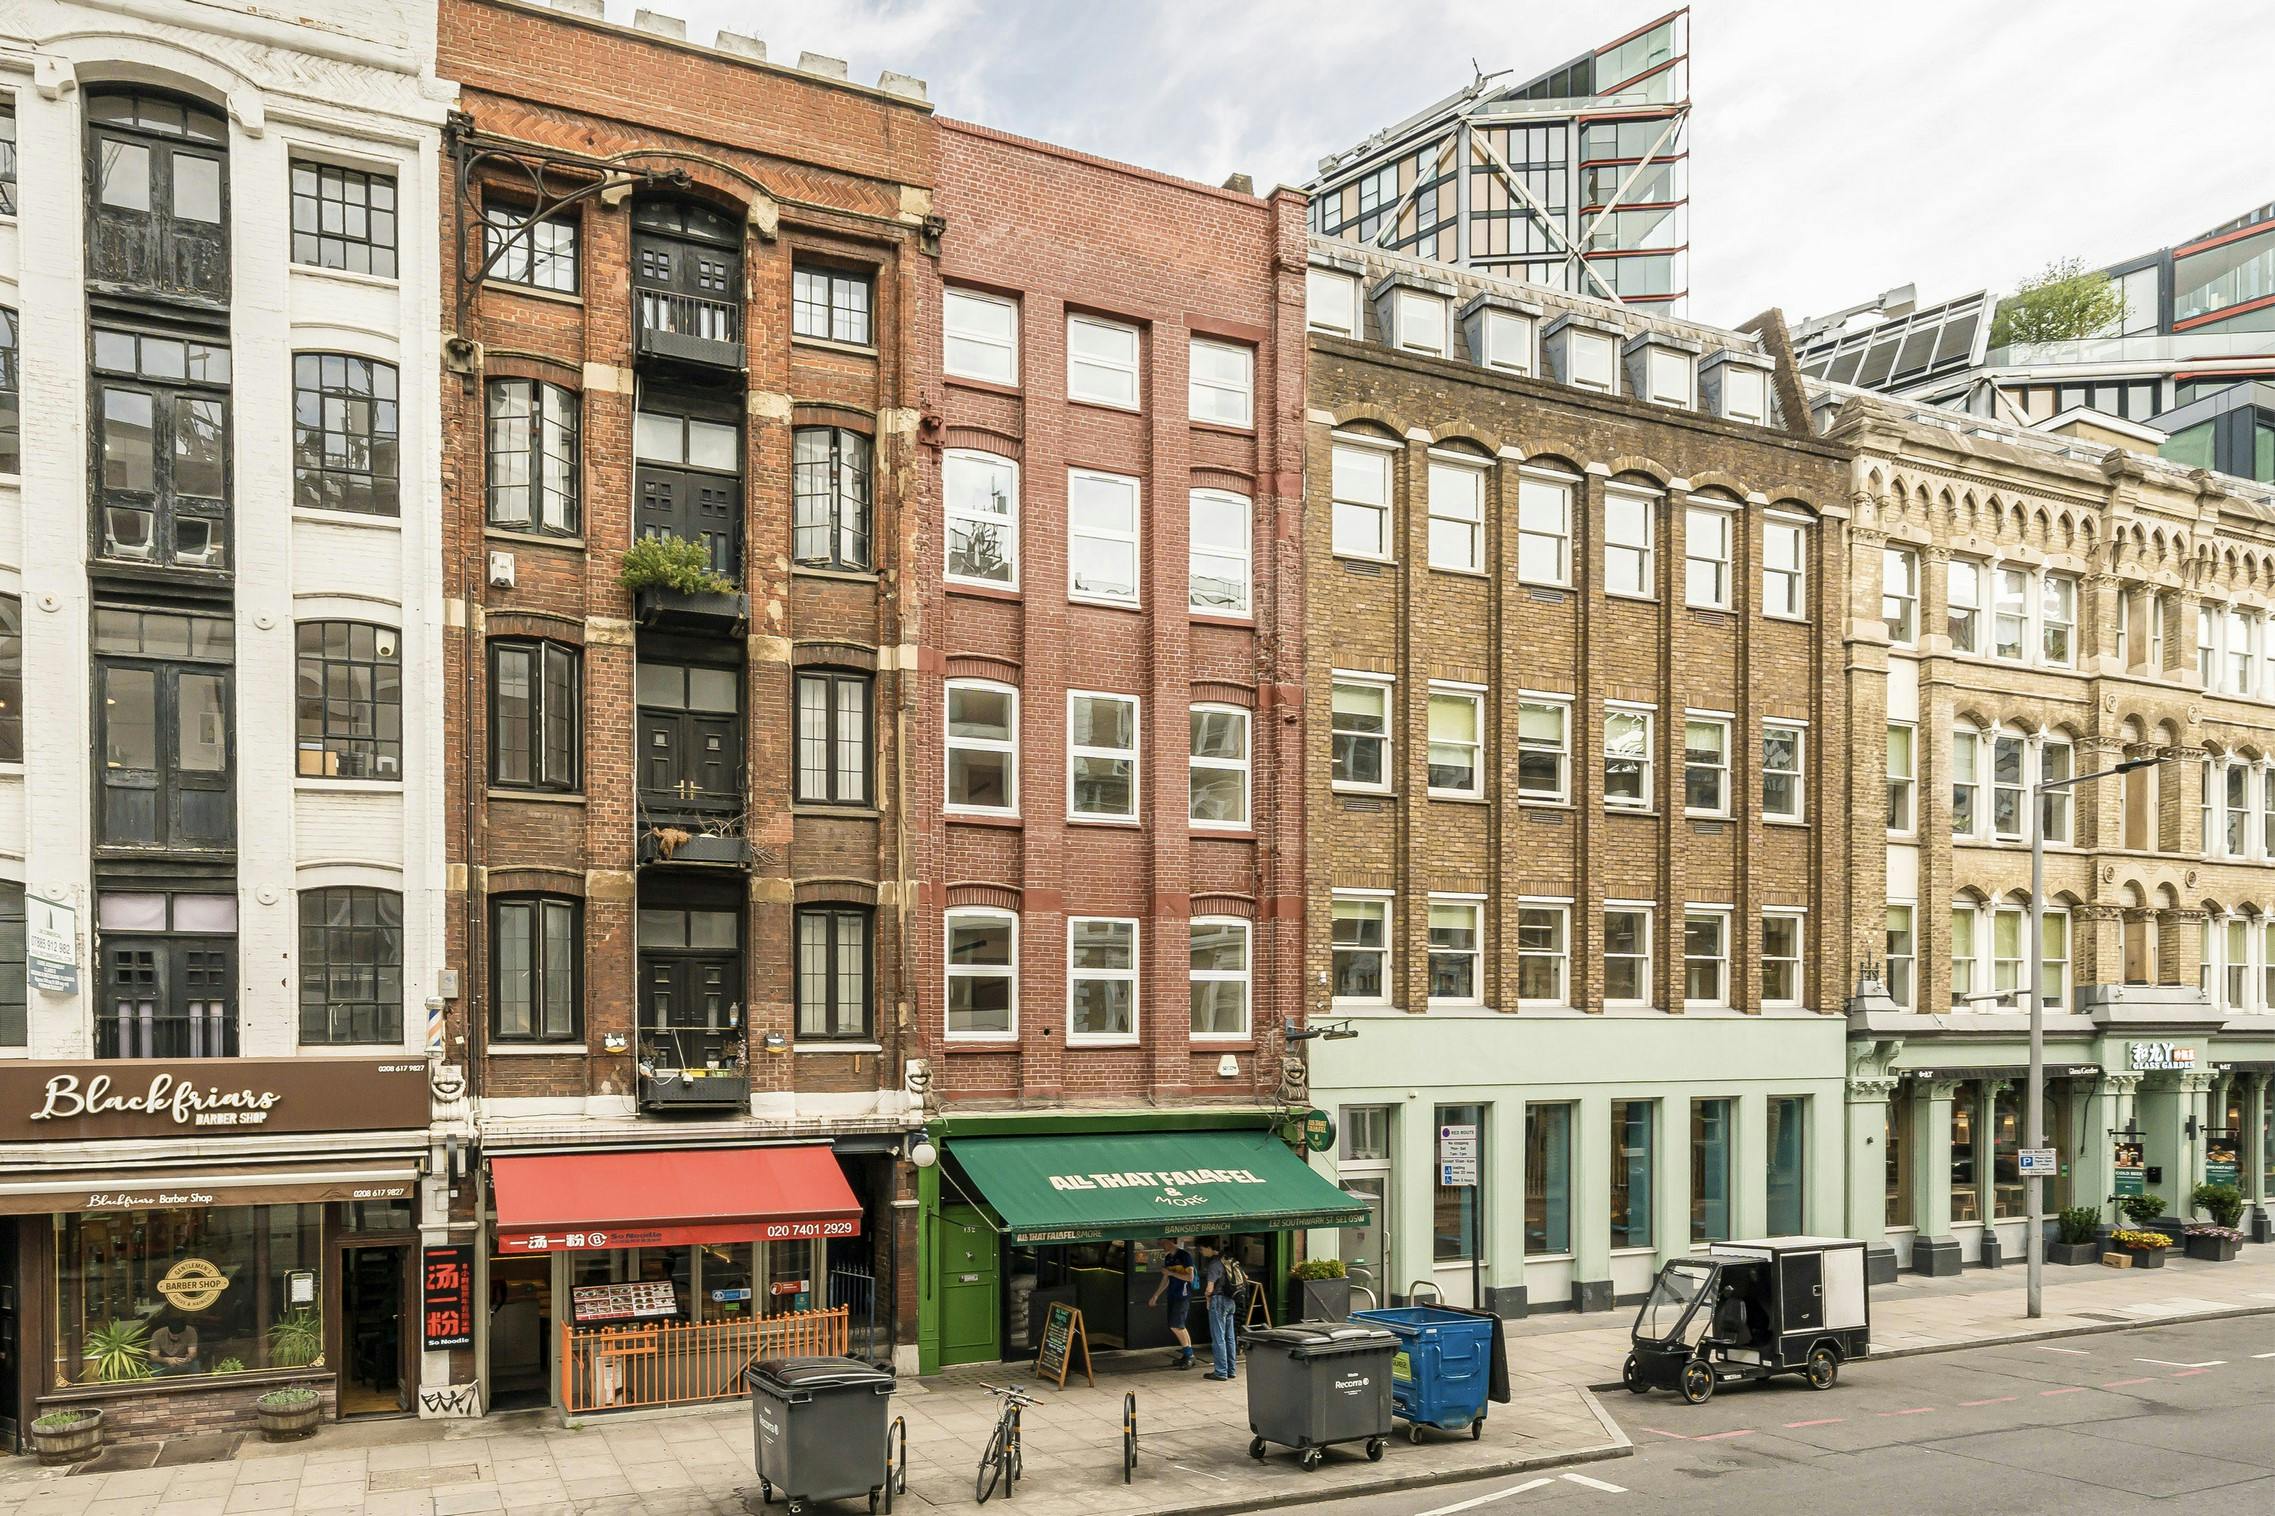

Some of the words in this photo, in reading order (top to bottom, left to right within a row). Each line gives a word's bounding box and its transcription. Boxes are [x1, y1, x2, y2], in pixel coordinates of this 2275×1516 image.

[2132, 1062, 2160, 1070] GLASS
[2162, 1062, 2194, 1070] GARDEN
[30, 1073, 281, 1124] Blackfriars
[195, 1113, 238, 1126] BARBER
[240, 1112, 268, 1124] SHOP
[2023, 1158, 2031, 1166] P
[1049, 1174, 1098, 1191] ALL
[1088, 1172, 1160, 1189] THAT
[1156, 1168, 1267, 1186] FALAFEL
[386, 1188, 404, 1196] 9827
[1163, 1187, 1184, 1197] &
[159, 1194, 188, 1204] Barber
[190, 1193, 213, 1204] Shop
[1154, 1194, 1209, 1208] MORE
[767, 1225, 789, 1237] 020
[792, 1224, 820, 1236] 7401
[824, 1222, 852, 1234] 2929
[1165, 1224, 1200, 1233] BANKSIDE
[1202, 1223, 1231, 1232] BRANCH
[1046, 1231, 1075, 1239] FALAFEL
[510, 1234, 585, 1249] 一汤一粉
[166, 1282, 197, 1290] BARBER
[199, 1280, 221, 1288] SHOP
[426, 1250, 459, 1336] 一汤一粉
[1336, 1380, 1362, 1389] Recorra
